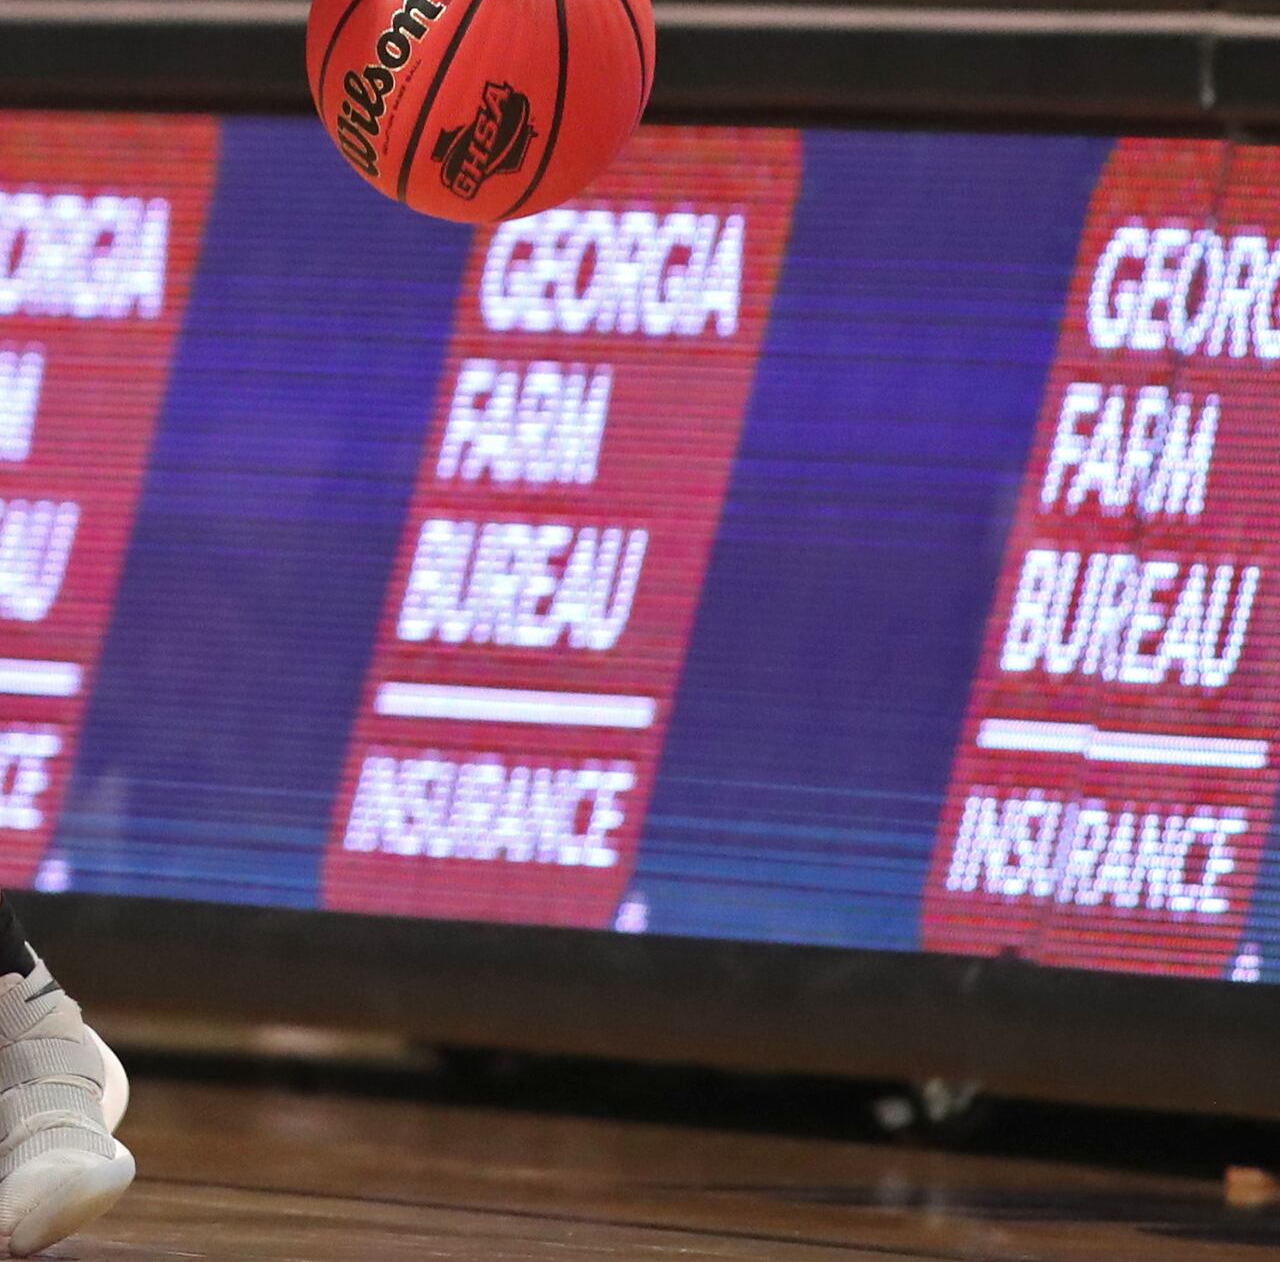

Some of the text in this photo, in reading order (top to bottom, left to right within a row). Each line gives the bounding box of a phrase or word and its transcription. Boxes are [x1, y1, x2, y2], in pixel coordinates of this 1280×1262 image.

[449, 83, 511, 199] GHSA
[481, 209, 744, 336] GEORGIA
[436, 361, 613, 483] FARM
[1041, 384, 1220, 514] FARM
[396, 520, 648, 650] BUREAU
[1000, 550, 1260, 688] BUREAU
[343, 750, 636, 867] INSURANCE
[945, 793, 1248, 913] INSURANCE
